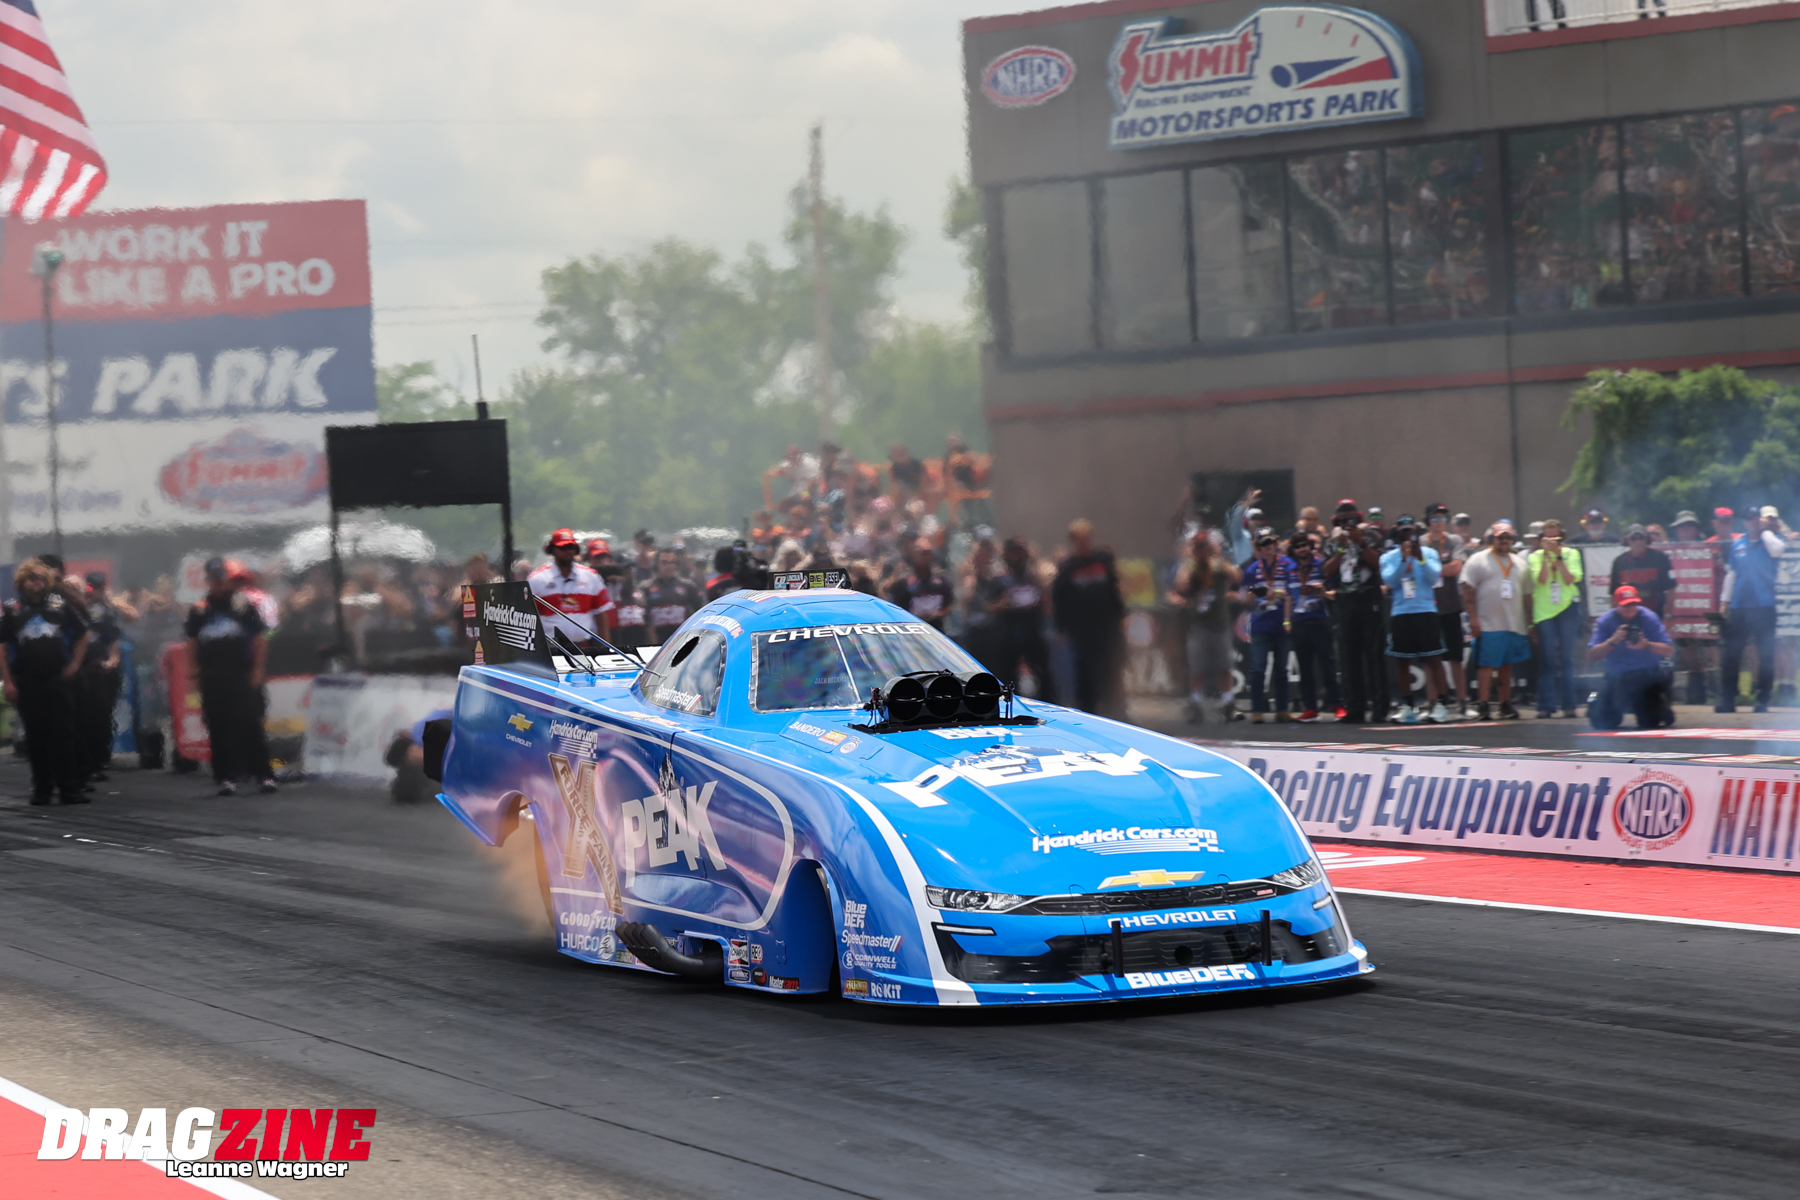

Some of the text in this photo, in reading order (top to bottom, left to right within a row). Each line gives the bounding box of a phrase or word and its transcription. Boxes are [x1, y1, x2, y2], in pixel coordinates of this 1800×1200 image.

[997, 57, 1062, 96] NHRA
[1115, 88, 1401, 140] MOTORSPORTS PARK
[59, 220, 269, 263] WORK IT
[57, 258, 336, 308] LIKE A PRO
[92, 347, 338, 414] PARK
[768, 624, 932, 643] CHEVROLET
[505, 733, 532, 748] CHEVROLET
[1373, 762, 1612, 841] Equipment
[1622, 785, 1683, 836] NHRA
[621, 780, 727, 888] PEAK
[841, 929, 894, 948] Speedmaster
[1107, 909, 1236, 929] CHEVROLET
[854, 953, 897, 964] CORNWELL
[876, 962, 897, 970] TOOLS
